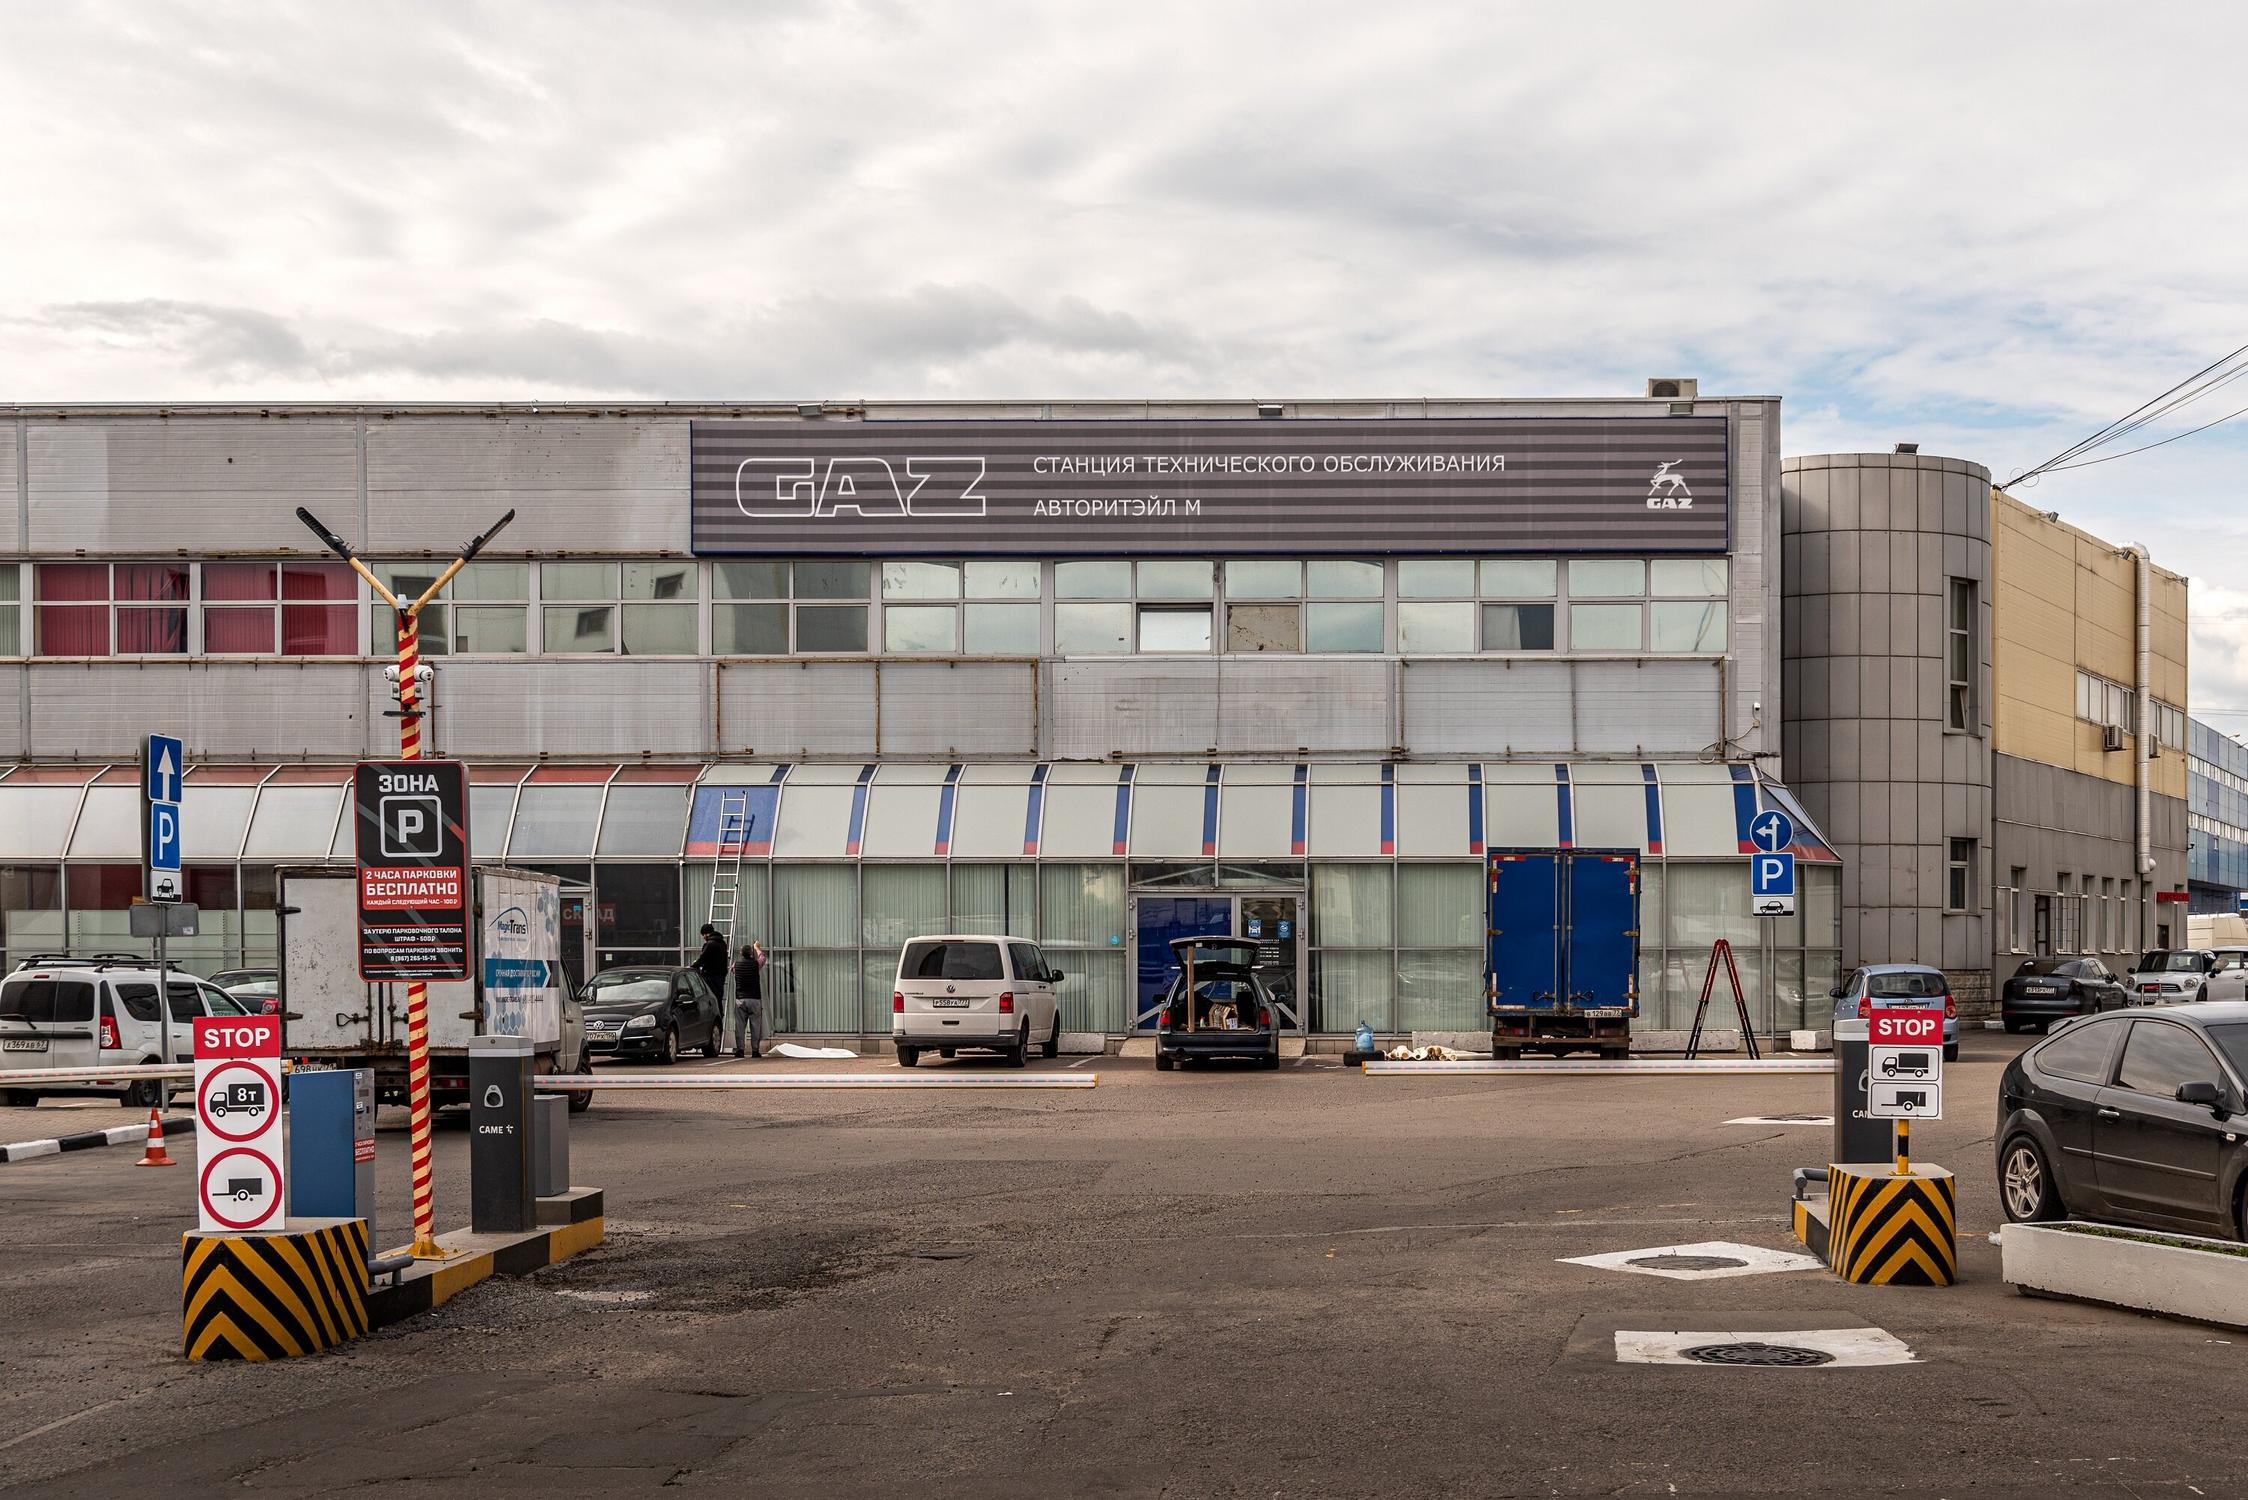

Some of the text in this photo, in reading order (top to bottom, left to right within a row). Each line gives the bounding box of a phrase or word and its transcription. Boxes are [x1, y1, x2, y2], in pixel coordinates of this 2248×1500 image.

[1033, 454, 1506, 476] СТАНЦИЯ ТЕХНИЧЕСКОГО ОБСЛУЖИВАНИЯ
[736, 456, 987, 517] GAZ
[1033, 495, 1201, 516] АВТОРИТЭЙЛ М
[1646, 498, 1693, 509] GAZ
[378, 774, 440, 792] ЗОНА
[158, 811, 174, 860] P
[398, 809, 424, 843] P
[366, 870, 457, 879] 2 ЧАСА ПАРКОВКИ
[1762, 859, 1784, 890] P
[366, 882, 458, 896] БЕСПЛАТНО
[366, 898, 392, 906] КАЖДЫЙ
[1878, 1018, 1936, 1036] STOP
[204, 1027, 271, 1048] STOP
[479, 1125, 504, 1134] CAME
